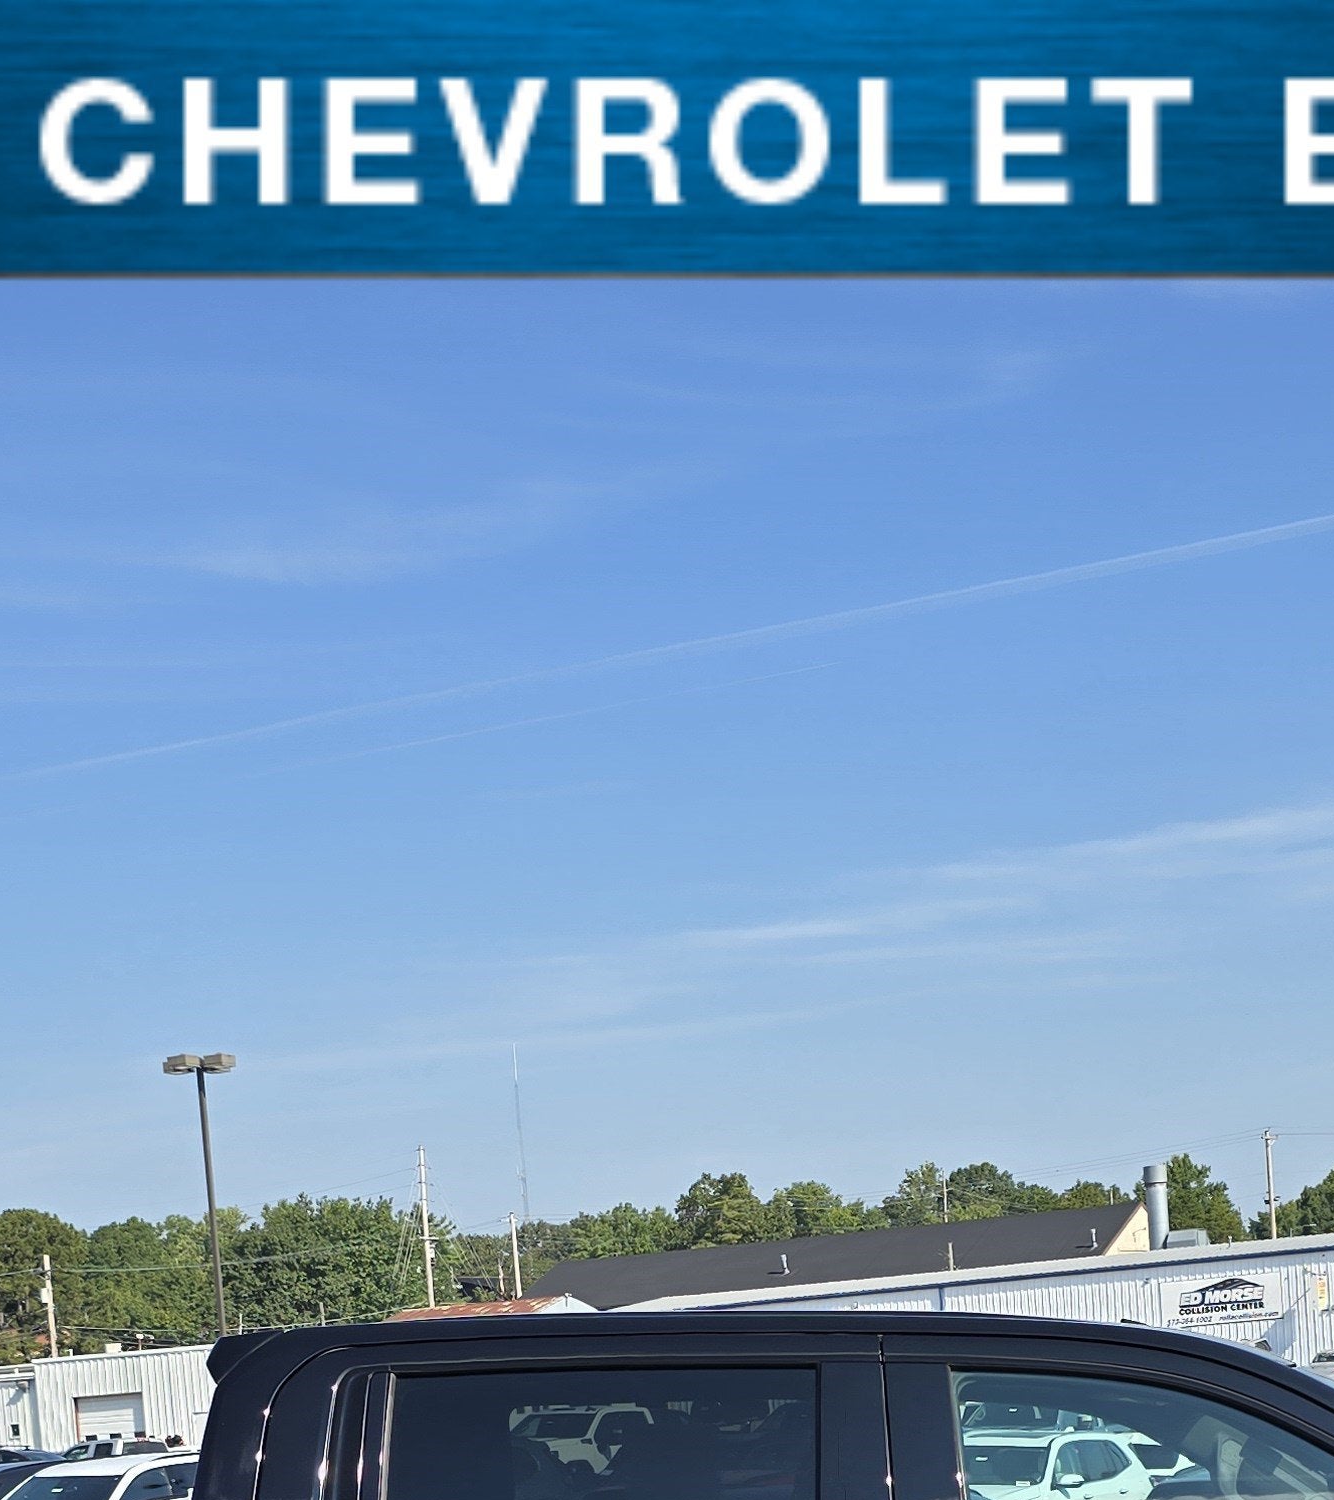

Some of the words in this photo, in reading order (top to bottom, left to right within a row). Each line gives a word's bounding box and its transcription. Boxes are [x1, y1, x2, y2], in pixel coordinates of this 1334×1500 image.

[1179, 1293, 1203, 1307] ED
[1204, 1285, 1265, 1304] MORSE
[1179, 1305, 1228, 1316] COLLISION
[1230, 1301, 1265, 1311] CENTER
